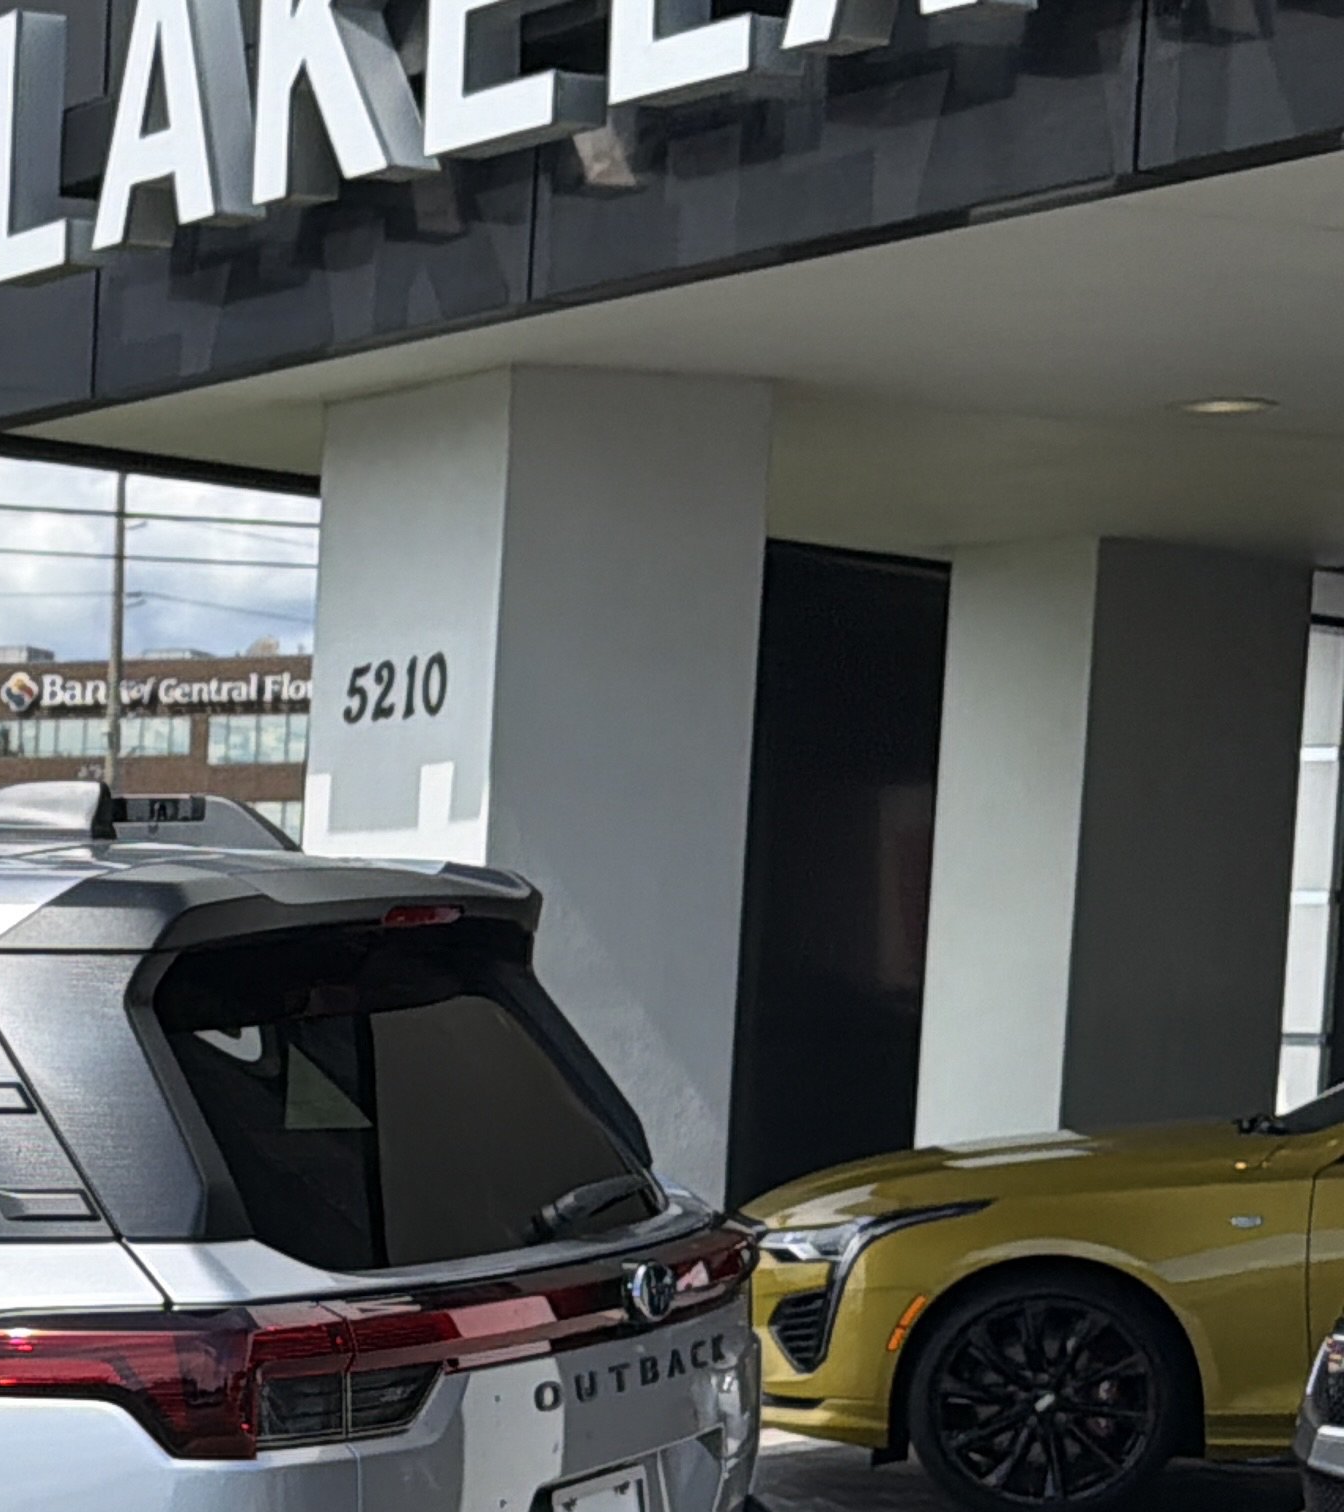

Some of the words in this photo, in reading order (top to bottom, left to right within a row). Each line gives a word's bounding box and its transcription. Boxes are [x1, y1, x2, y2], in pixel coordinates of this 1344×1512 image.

[158, 671, 258, 704] Central
[343, 651, 448, 725] 5210
[533, 1332, 726, 1413] OUTBACK
